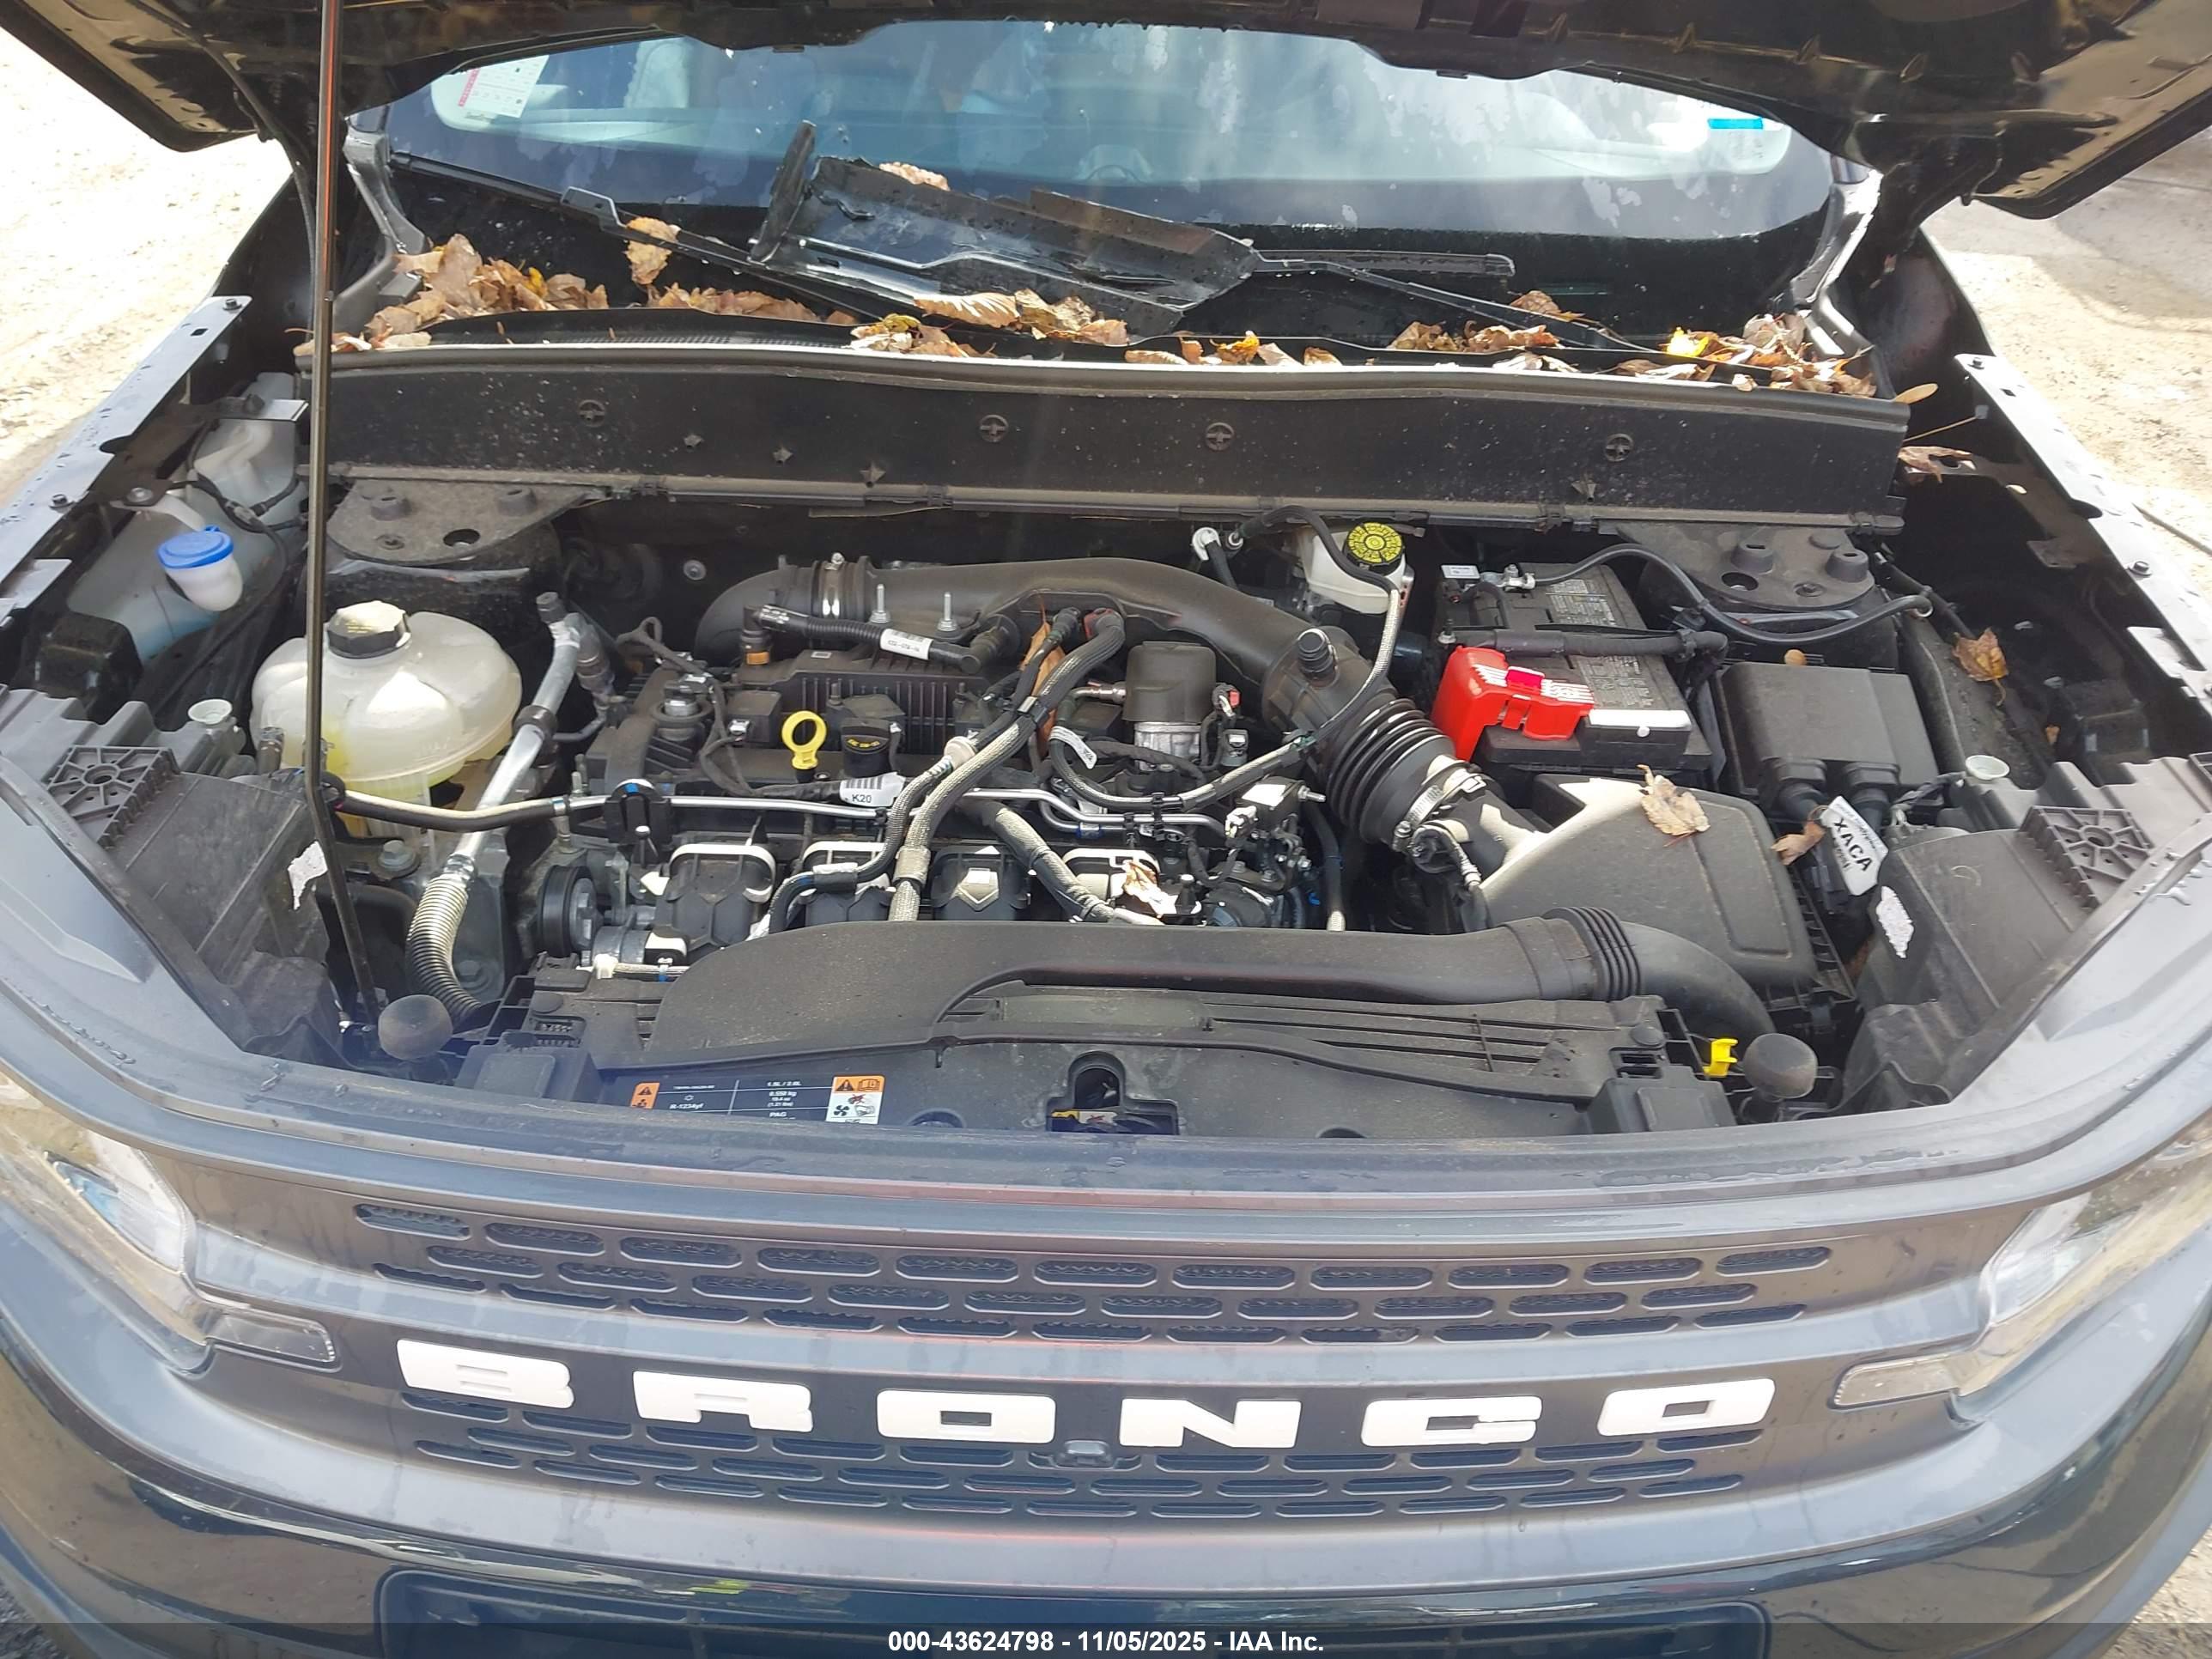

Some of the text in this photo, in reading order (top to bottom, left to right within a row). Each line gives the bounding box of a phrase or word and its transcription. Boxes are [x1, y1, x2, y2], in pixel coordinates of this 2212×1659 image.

[851, 793, 872, 804] K20
[1834, 817, 1873, 872] XACA
[397, 1339, 1776, 1449] BRONCO
